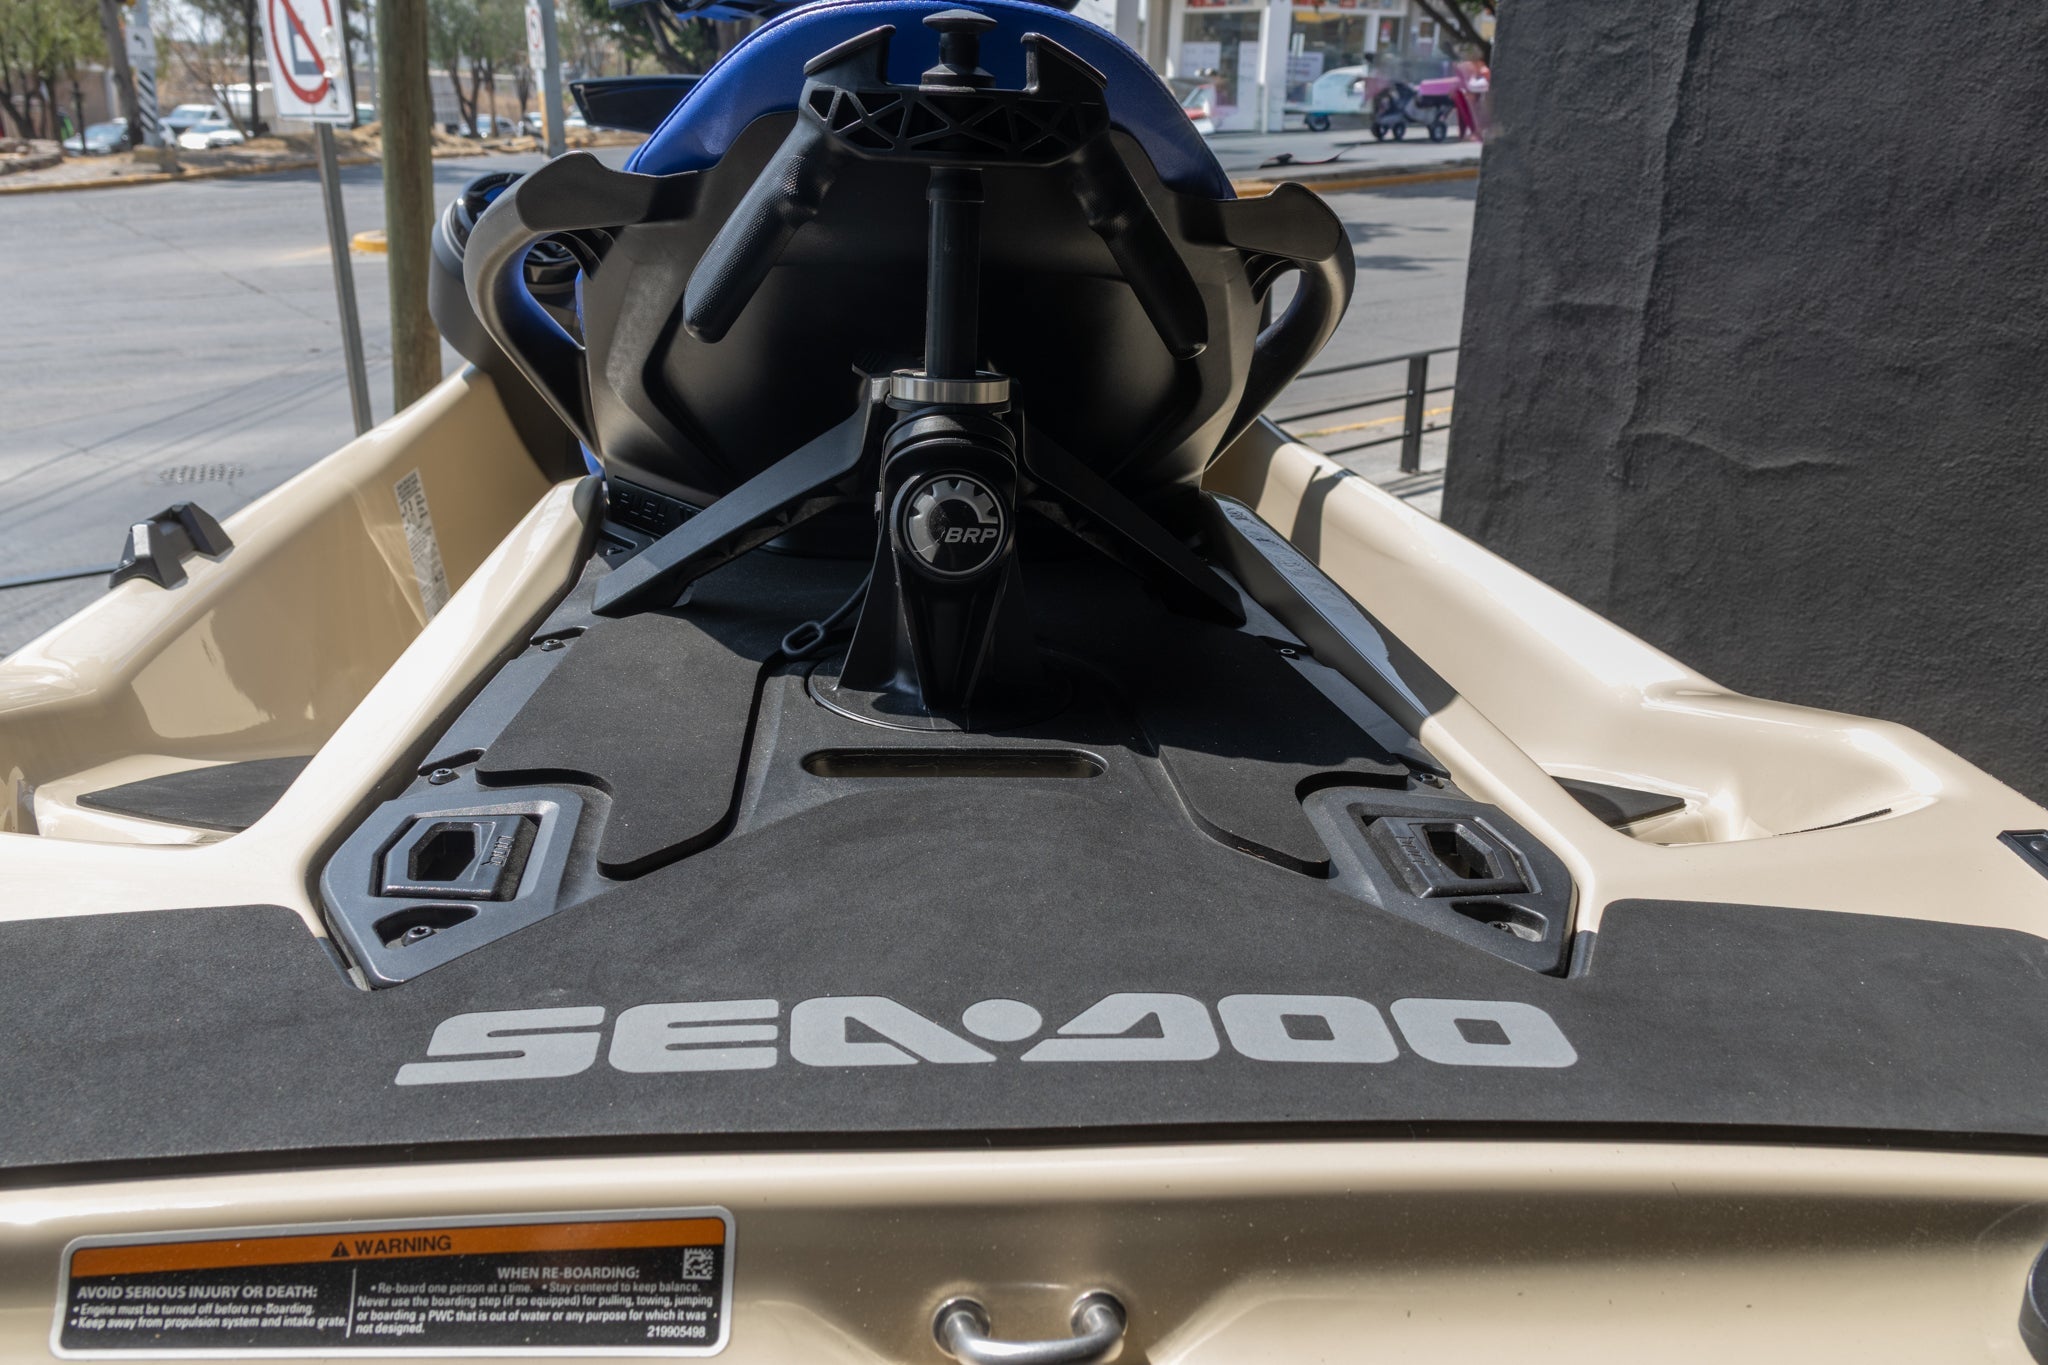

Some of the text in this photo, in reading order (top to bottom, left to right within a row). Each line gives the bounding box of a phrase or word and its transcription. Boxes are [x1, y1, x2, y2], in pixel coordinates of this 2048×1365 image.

[944, 527, 998, 544] BRP
[354, 1235, 452, 1256] WARNING
[497, 1266, 640, 1279] WHEN RE-BOARDING:
[77, 1286, 318, 1299] AVOID SERIOUS INJURY OR DEATH:
[377, 1282, 533, 1295] Re-board one person at a time.
[549, 1281, 700, 1294] Stay centered to keep balance.
[357, 1294, 714, 1309] Never use the boarding step (if so equipped) for pulling, towing, jumping
[80, 1303, 116, 1317] Engine
[118, 1304, 144, 1315] must
[146, 1303, 160, 1315] be
[161, 1303, 197, 1315] turned
[198, 1302, 213, 1314] off
[214, 1302, 249, 1315] before
[357, 1308, 707, 1323] or boarding a PWC that is out of water or any purpose for which it was
[77, 1316, 348, 1331] Keep away from propulsion system and intake grate.
[355, 1322, 426, 1336] not designed.
[646, 1325, 706, 1338] 219905498
